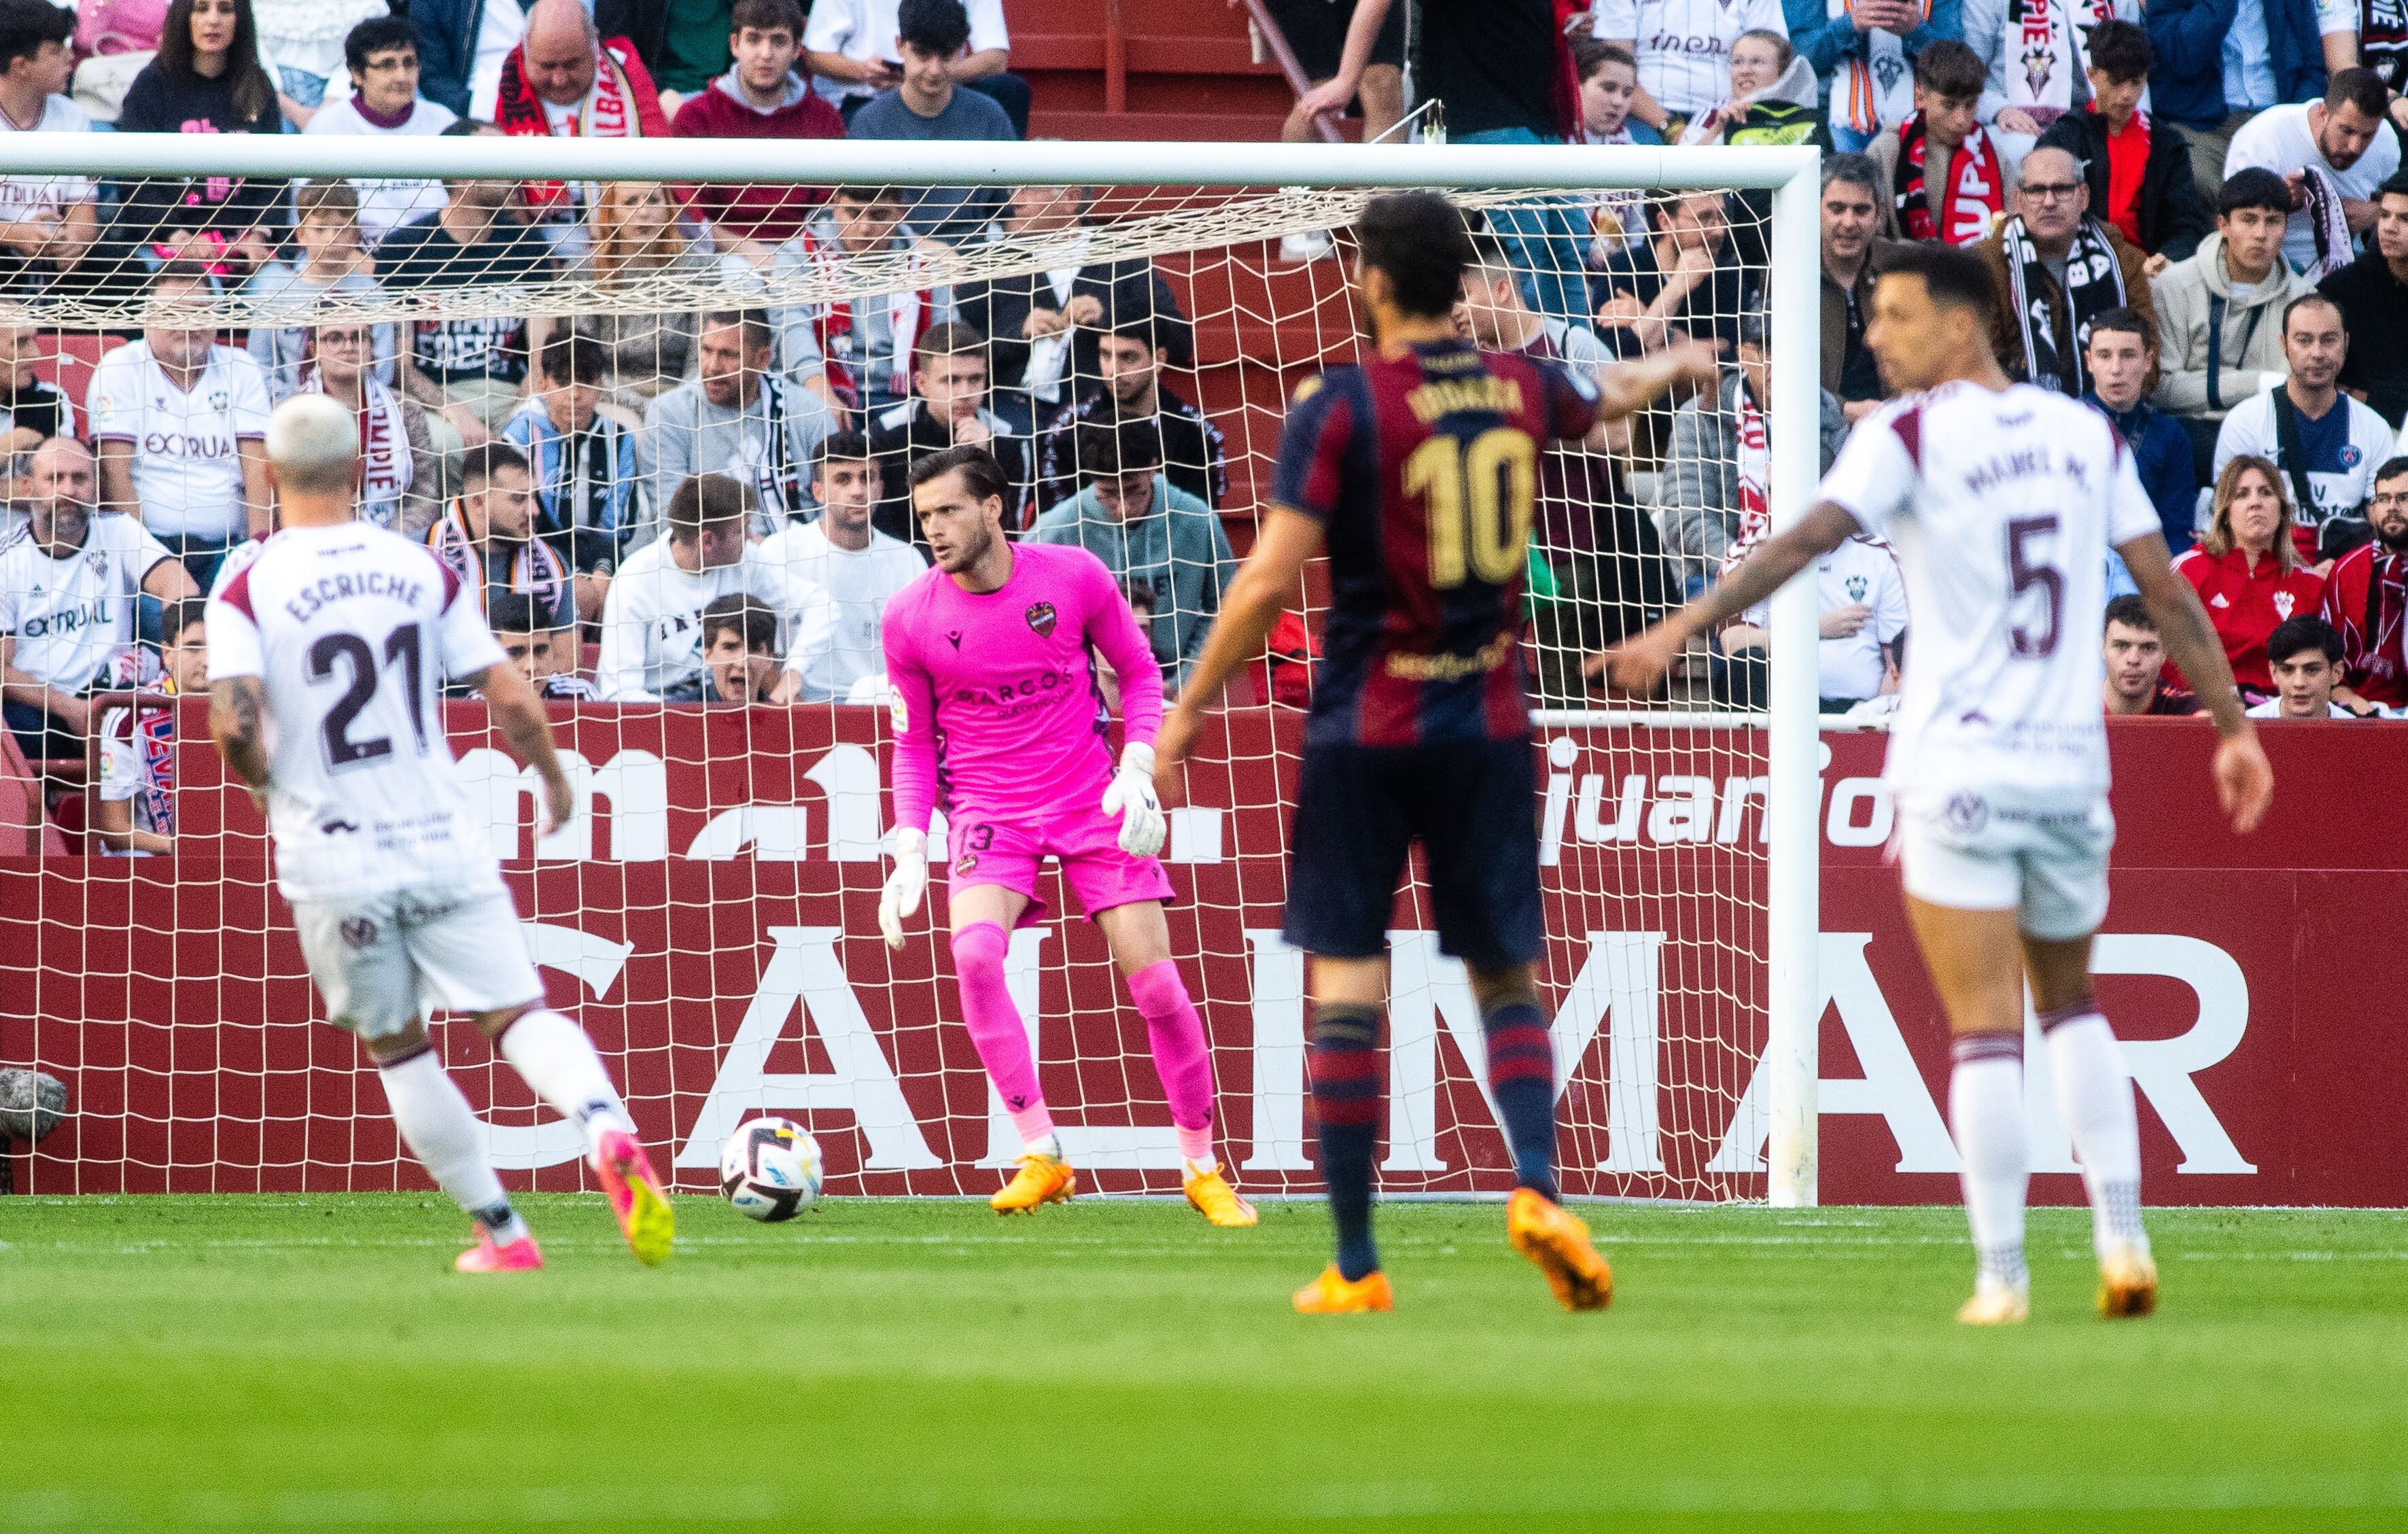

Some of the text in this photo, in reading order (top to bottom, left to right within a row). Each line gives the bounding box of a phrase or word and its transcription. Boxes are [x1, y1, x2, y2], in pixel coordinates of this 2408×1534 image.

[1401, 428, 1537, 589] 10
[24, 602, 113, 638] EXTRUAL
[284, 571, 422, 624] ESCRICHE
[2008, 515, 2064, 659] 5
[306, 623, 429, 775] 21
[1539, 736, 1893, 865] juano
